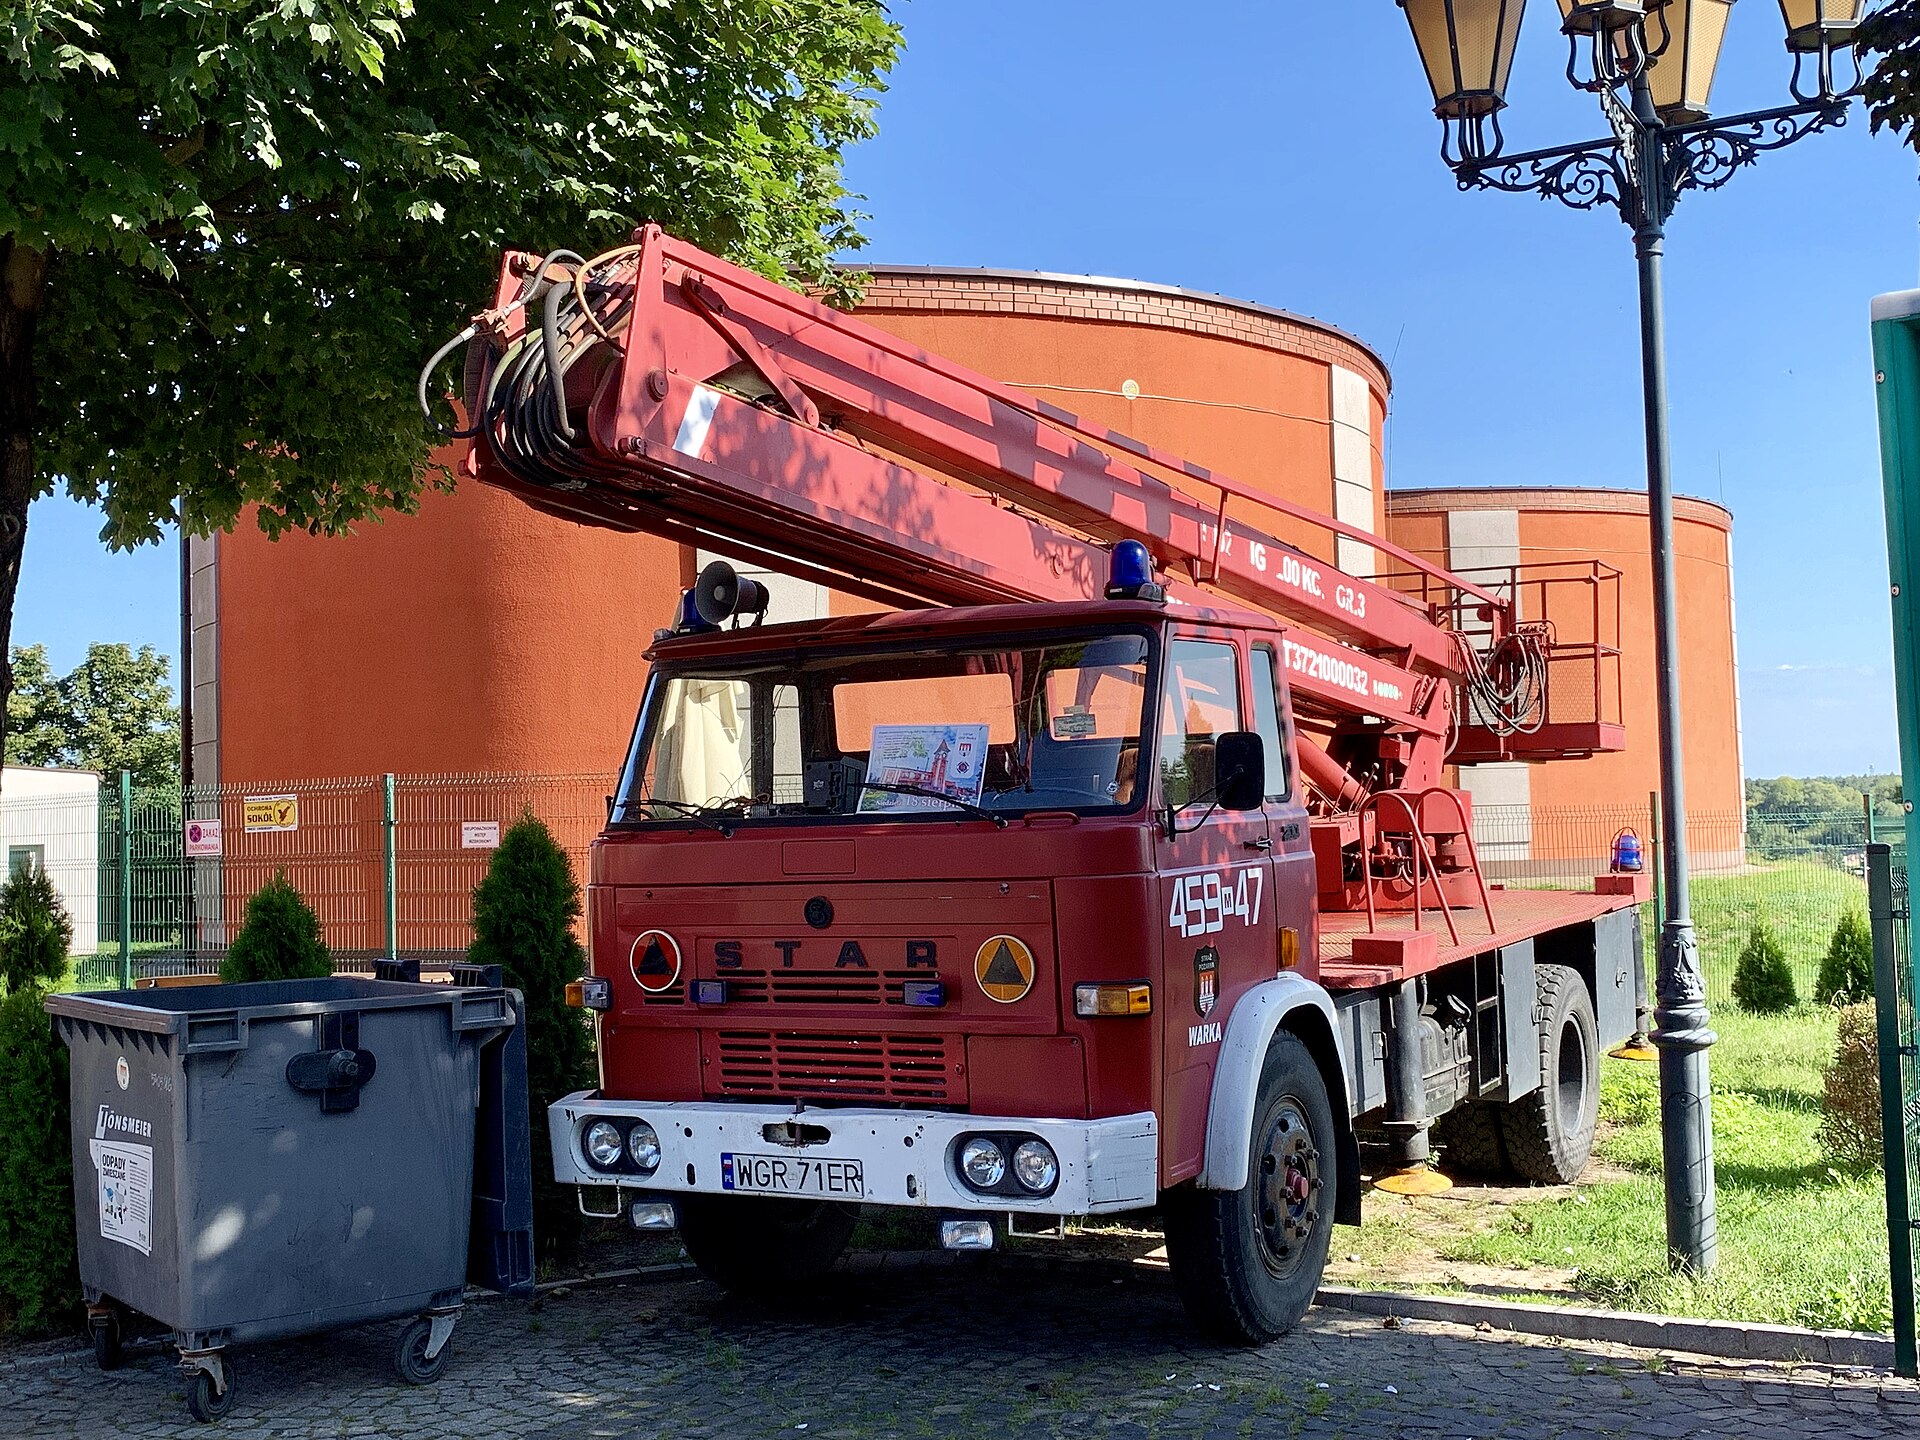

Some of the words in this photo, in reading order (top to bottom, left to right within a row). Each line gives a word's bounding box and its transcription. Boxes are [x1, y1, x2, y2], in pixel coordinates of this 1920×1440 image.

[906, 795, 918, 807] 18
[247, 812, 273, 823] SOKÓŁ
[714, 939, 938, 969] STAR
[1188, 1022, 1222, 1048] WARKA
[102, 1153, 127, 1173] ODPADY
[724, 1174, 733, 1184] PL
[737, 1158, 789, 1189] WGR
[797, 1161, 861, 1193] 71ER
